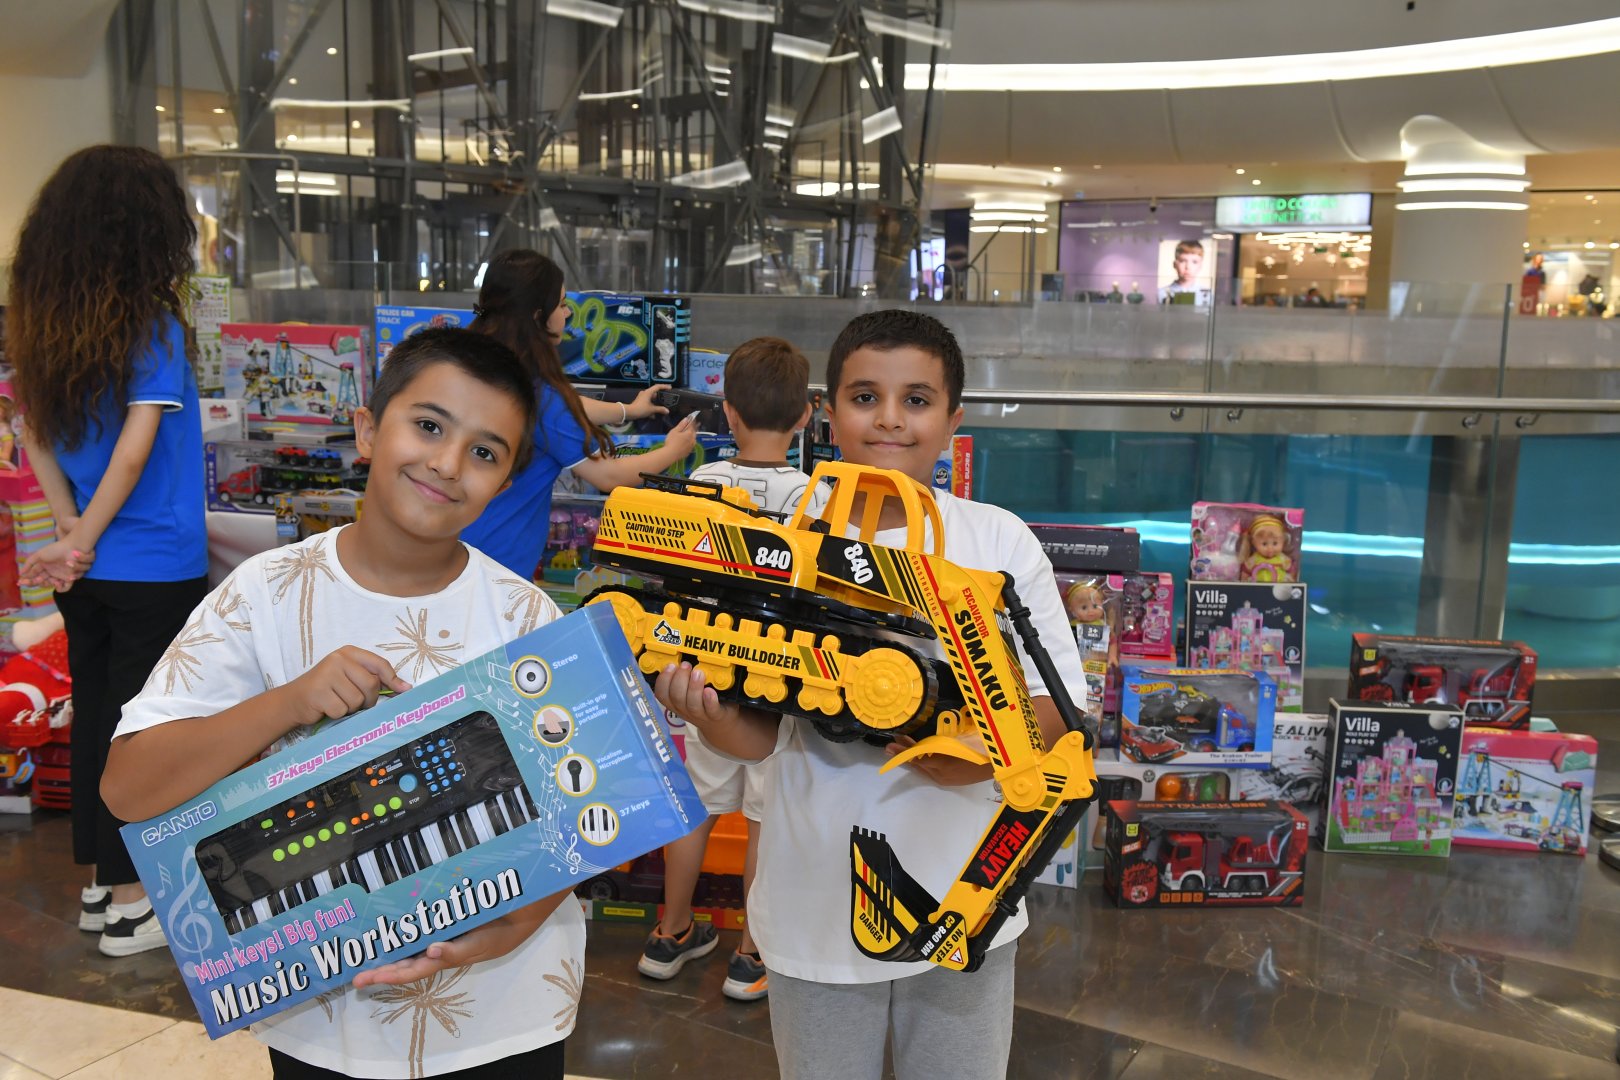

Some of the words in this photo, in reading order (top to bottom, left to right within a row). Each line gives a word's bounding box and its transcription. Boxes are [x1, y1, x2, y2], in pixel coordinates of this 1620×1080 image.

[626, 522, 654, 534] CAUTION
[656, 525, 666, 536] NO
[666, 528, 684, 539] STEP
[754, 546, 792, 570] 840
[844, 542, 874, 585] 840
[912, 555, 939, 617] CONSTRUCTION
[1195, 590, 1228, 604] Villa
[962, 586, 990, 639] EXCAVATOR
[552, 654, 578, 670] Stereo
[684, 634, 726, 654] HEAVY
[728, 644, 800, 670] BULLDOZER
[954, 610, 1010, 711] SUMAKU
[572, 699, 594, 712] Built-in
[594, 692, 607, 704] grip
[585, 704, 598, 714] easy
[578, 708, 608, 726] portability
[1345, 716, 1381, 732] Villa
[266, 756, 324, 790] 37-Keys
[324, 722, 394, 762] Electronic
[396, 686, 466, 730] Keyboard
[599, 752, 632, 770] Microphone
[620, 806, 630, 818] 37
[631, 800, 650, 814] keys
[664, 776, 688, 824] CANTO
[142, 800, 218, 846] CANTO
[978, 823, 1008, 862] EXCAVATOR
[981, 820, 1031, 884] HEAVY
[194, 953, 234, 984] Mini
[233, 930, 285, 965] keys!
[283, 918, 318, 948] Big
[316, 898, 357, 934] fun!
[858, 912, 883, 944] DANGER
[932, 926, 947, 943] 840
[952, 928, 964, 942] NO
[210, 960, 310, 1027] Music
[310, 866, 524, 982] Workstation
[936, 941, 954, 962] STEP
